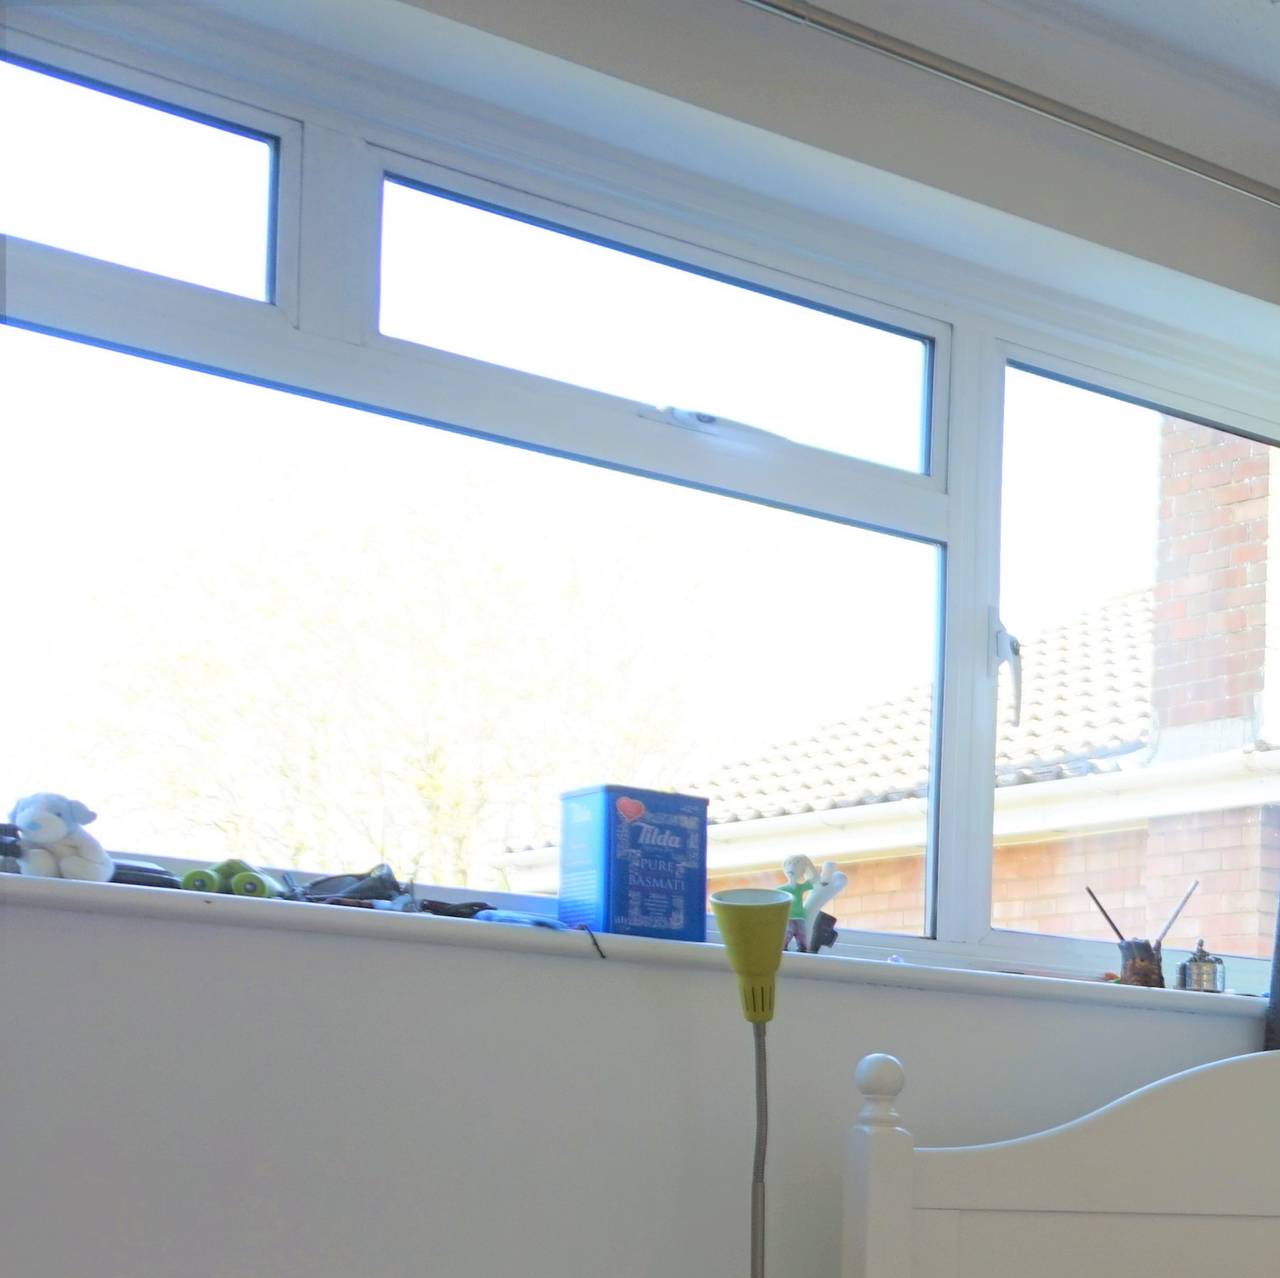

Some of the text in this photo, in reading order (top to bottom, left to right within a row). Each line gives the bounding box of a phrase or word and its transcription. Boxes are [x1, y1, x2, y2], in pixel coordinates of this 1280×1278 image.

[633, 822, 681, 848] Tilda
[640, 858, 674, 873] PURE
[629, 875, 685, 891] BASMATI
